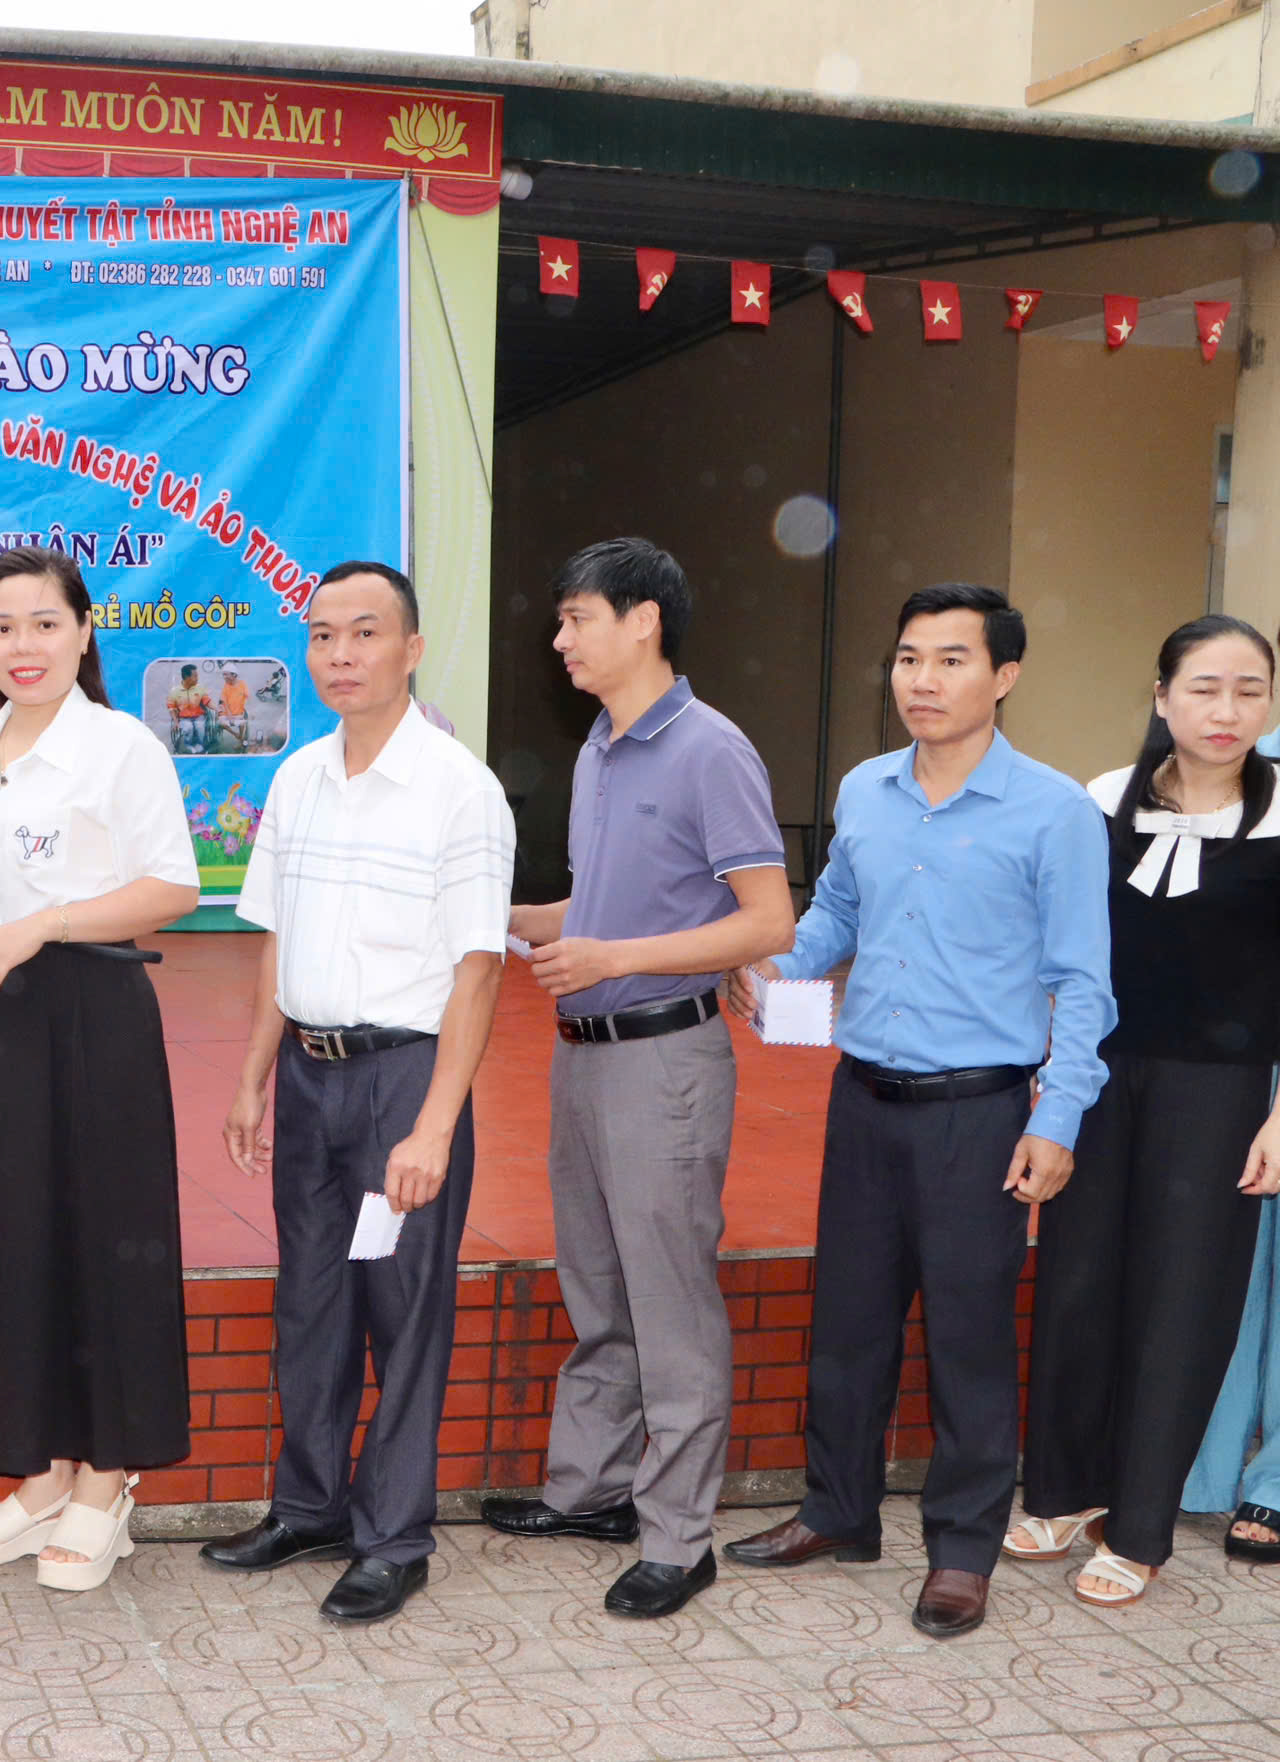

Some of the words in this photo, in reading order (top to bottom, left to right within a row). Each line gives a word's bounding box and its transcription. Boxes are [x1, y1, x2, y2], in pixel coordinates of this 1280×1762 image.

[61, 82, 205, 136] MUÔN
[85, 201, 139, 248] TẬT
[146, 197, 215, 242] TỈNH
[222, 203, 299, 252] NGHỆ
[306, 209, 349, 246] AN
[4, 259, 30, 281] AN
[71, 262, 95, 284] ĐT:
[99, 262, 147, 285] 02386
[151, 263, 179, 286] 282
[183, 264, 211, 287] 228
[226, 266, 265, 287] 0347
[270, 267, 296, 288] 601
[301, 267, 326, 289] 591
[81, 331, 251, 395] MỪNG
[2, 415, 65, 466] VĂN
[70, 437, 159, 508] NGHỆ
[198, 490, 243, 545] ẢO
[242, 527, 319, 621] THUẬ
[92, 592, 120, 629] RẺ
[128, 589, 177, 630] MỒ
